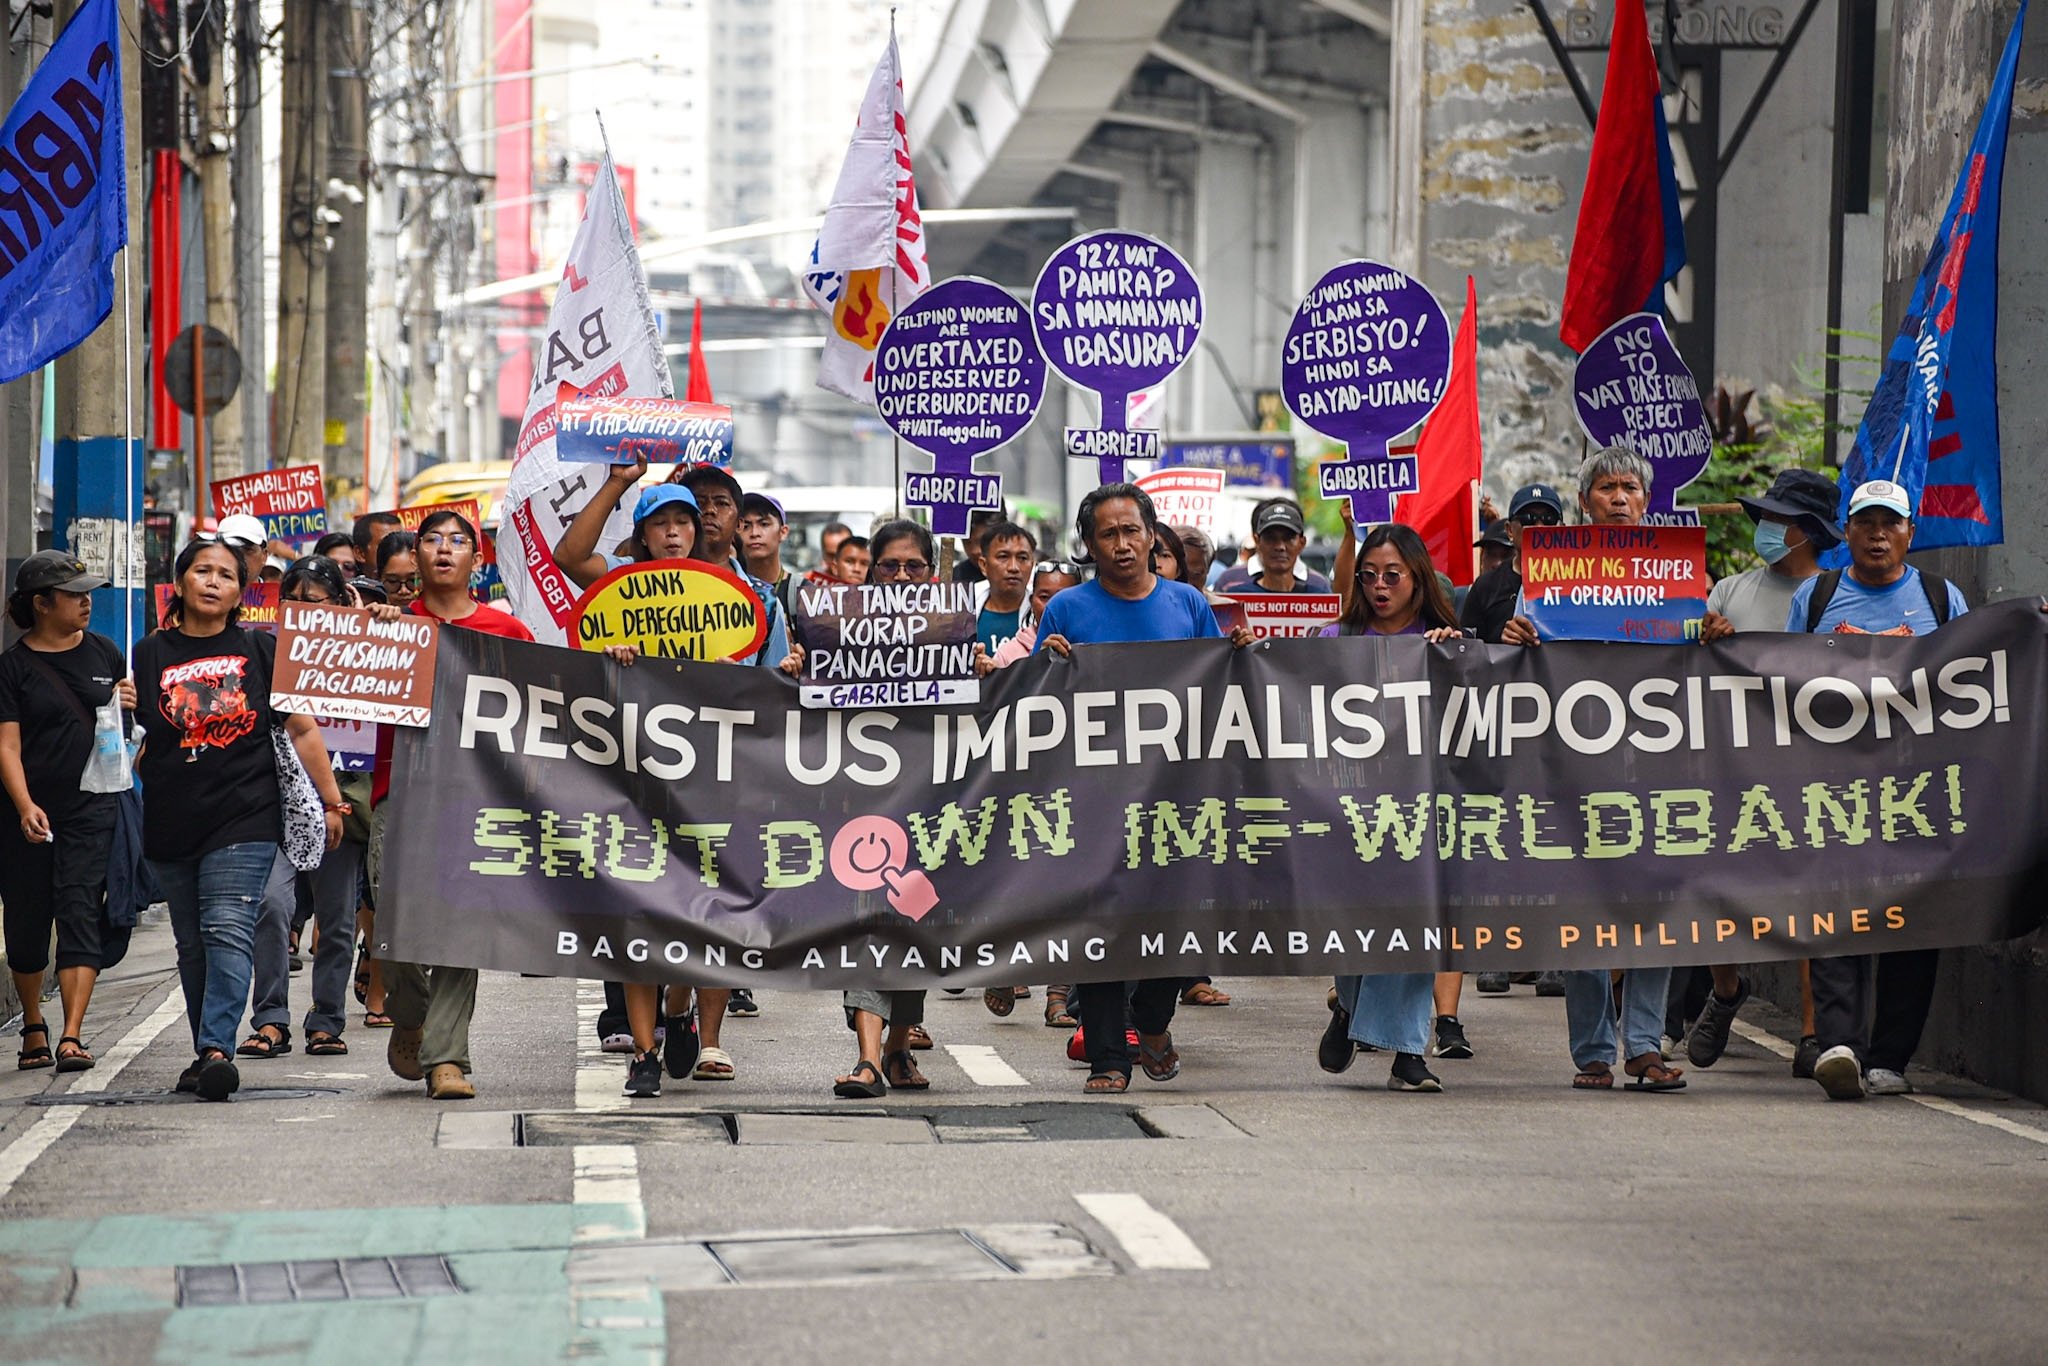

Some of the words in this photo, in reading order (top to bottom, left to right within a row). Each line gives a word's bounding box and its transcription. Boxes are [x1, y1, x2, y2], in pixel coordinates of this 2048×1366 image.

[1566, 5, 1785, 48] BONG
[1075, 241, 1120, 269] 12%
[1058, 266, 1176, 299] PAHIRAP
[1302, 279, 1353, 315] BUWIS
[1353, 271, 1407, 297] NAMIN
[896, 306, 957, 331] FILIPINO
[960, 306, 1018, 324] WOMEN
[1038, 302, 1072, 331] SA
[1311, 301, 1362, 328] ILAAN
[1365, 296, 1389, 317] SA
[938, 323, 970, 338] ARE
[1286, 313, 1428, 365] SERBISYO!
[1614, 326, 1653, 355] NO
[884, 337, 1034, 371] OVERTAXED.
[1063, 325, 1185, 368] IBASURA!
[1305, 360, 1360, 384] HINDI
[1365, 355, 1393, 376] SA
[1620, 352, 1657, 377] TO
[877, 367, 1030, 394] UNDERSERVED.
[1578, 379, 1625, 410] VAT
[1626, 374, 1666, 405] BASE
[880, 392, 1036, 417] OVERBURDENED.
[1298, 377, 1443, 418] BAYAD-UTANG!
[561, 413, 586, 433] AT
[898, 418, 1002, 443] #VATTanggalin
[1621, 402, 1684, 431] REJECT
[1068, 430, 1156, 457] GABRIELA
[221, 469, 320, 506] REHABILITAS-
[906, 476, 998, 506] GABRIELA
[1322, 461, 1410, 492] GABRIELA
[268, 490, 316, 513] HINDI
[1153, 496, 1172, 510] RE
[1179, 496, 1215, 510] NOT
[262, 512, 325, 539] APPING
[1158, 514, 1213, 533] ALE!
[1532, 529, 1592, 550] DONALD
[1528, 557, 1596, 583] KAAWAY
[1601, 557, 1626, 580] NG
[1631, 557, 1694, 581] TSUPER
[536, 562, 572, 615] LGBT
[619, 571, 685, 600] JUNK
[1543, 586, 1563, 606] AT
[1570, 585, 1665, 607] OPERATOR!
[800, 585, 849, 618] VAT
[1268, 602, 1288, 614] NOT
[1290, 602, 1309, 614] FOR
[1311, 602, 1338, 614] SALE!
[284, 607, 361, 636] LUPANG
[579, 611, 614, 641] OIL
[622, 601, 755, 639] DEREGULATION
[840, 615, 929, 647] KORAP
[163, 658, 241, 686] DERRICK
[810, 642, 977, 680] PANAGUTIN!
[294, 668, 414, 700] IPAGLABAN!
[204, 712, 256, 740] ROSE
[459, 674, 757, 782] RESIST
[784, 709, 903, 787] US
[931, 680, 1433, 785] IMPERIALIST
[1439, 649, 2012, 758] IMPOSITIONS!
[468, 806, 733, 889] SHUT
[556, 930, 764, 970] BAGONG
[801, 936, 1108, 970] ALYANSANG
[1140, 926, 1442, 958] MAKABAYAN
[1560, 904, 1907, 950] PHILIPPINES
